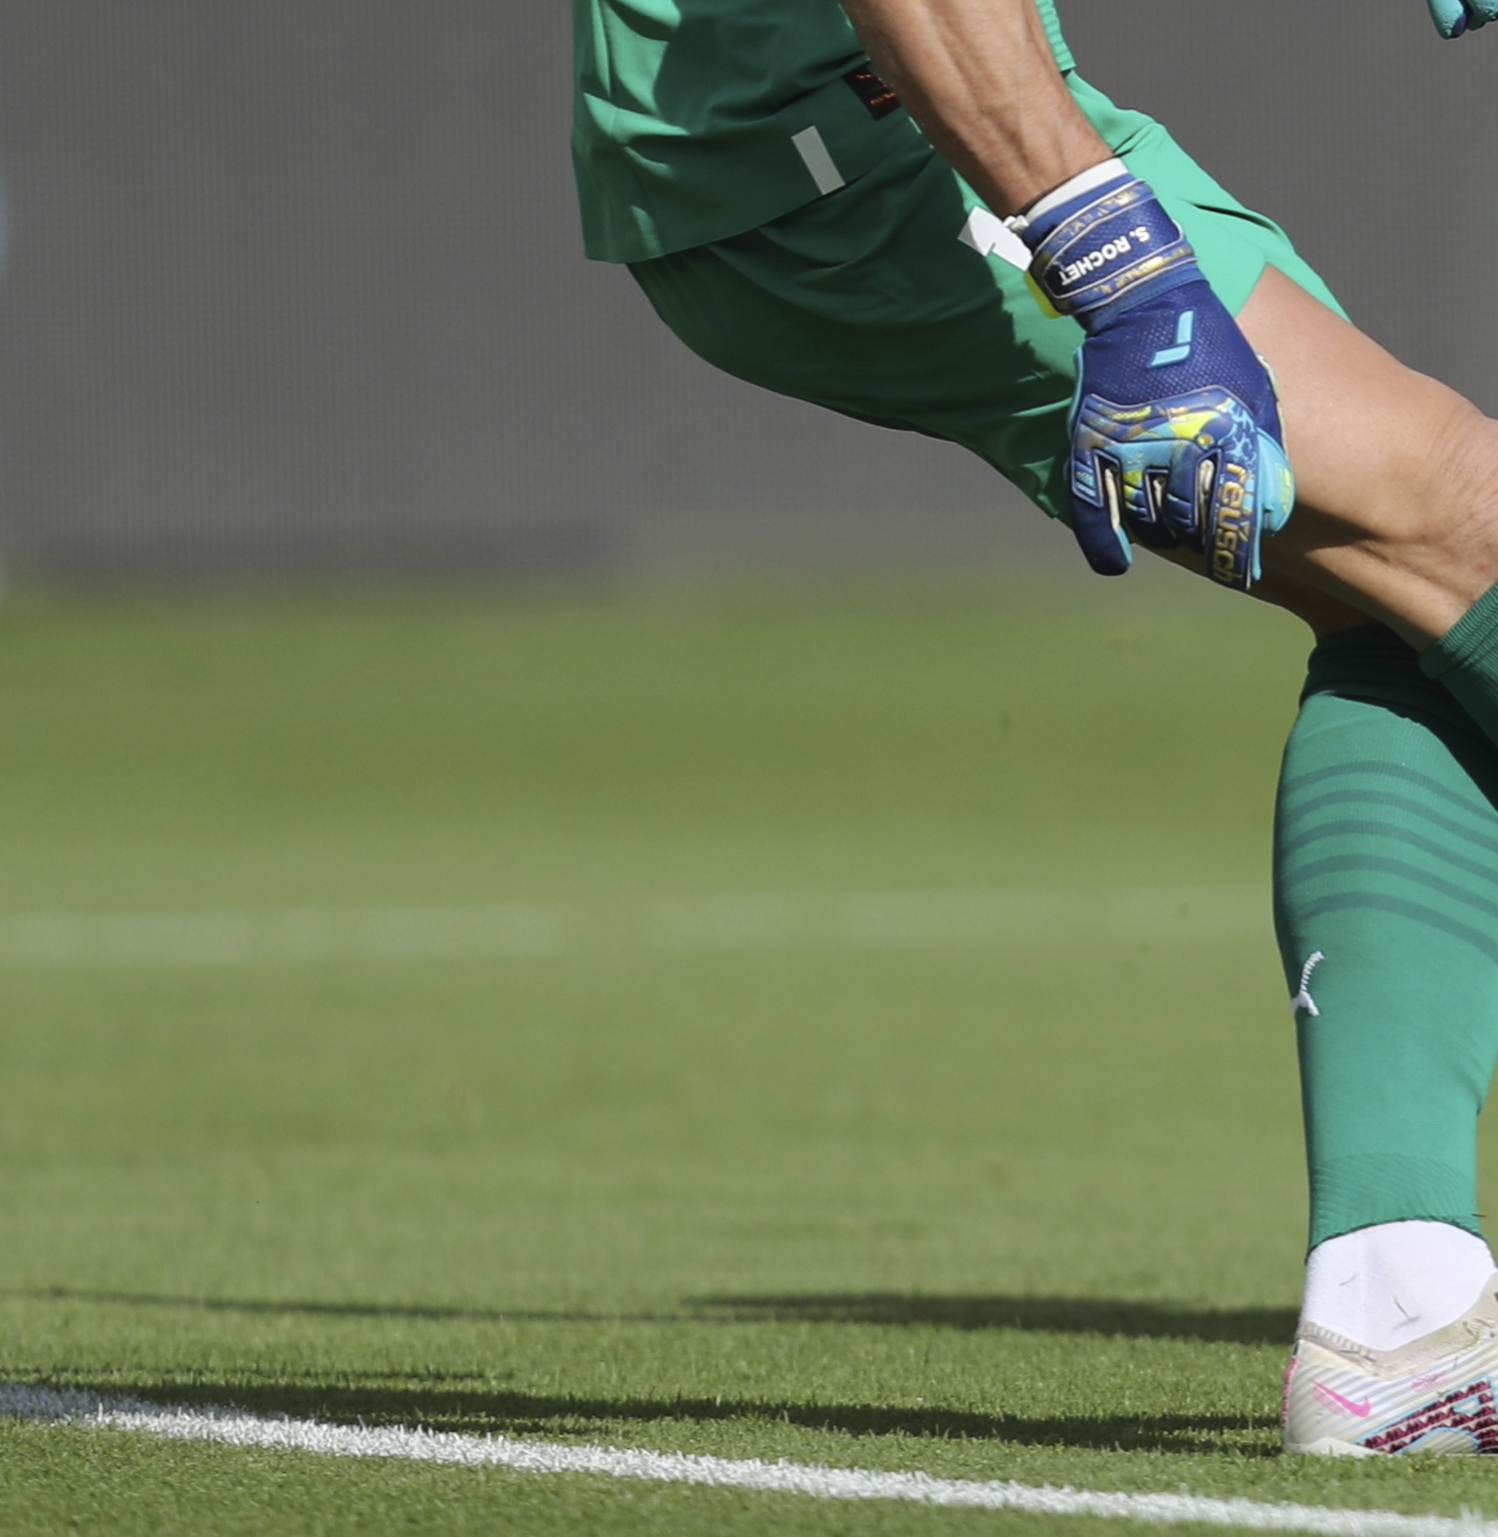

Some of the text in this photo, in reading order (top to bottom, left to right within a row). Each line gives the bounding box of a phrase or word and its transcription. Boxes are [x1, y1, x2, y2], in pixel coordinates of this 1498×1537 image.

[1058, 226, 1151, 286] S. ROCHET
[1213, 462, 1247, 583] reusch
